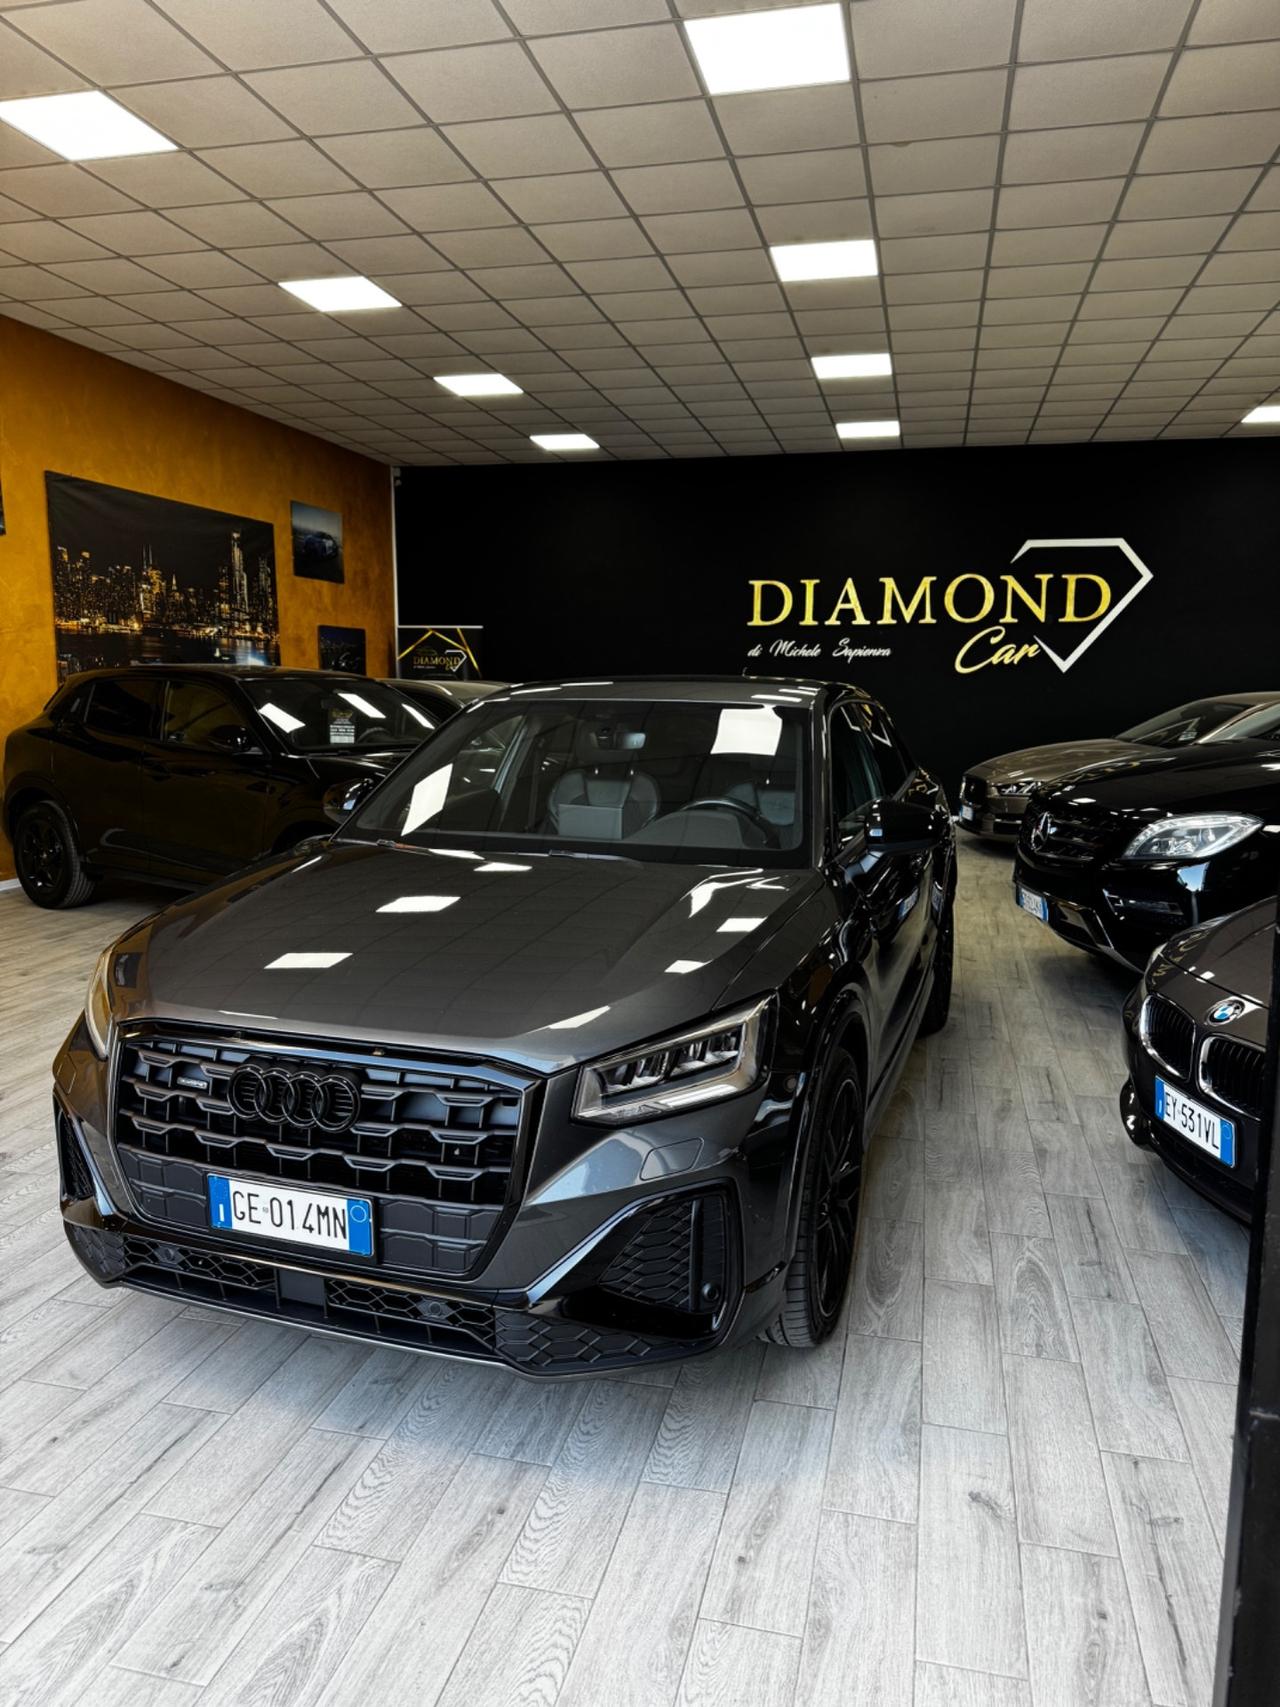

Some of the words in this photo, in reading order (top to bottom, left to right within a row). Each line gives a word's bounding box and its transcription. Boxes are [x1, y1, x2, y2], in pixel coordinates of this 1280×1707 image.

[747, 573, 1112, 626] DIAMOND
[413, 655, 461, 666] DIAMOND
[747, 643, 763, 658] di
[769, 640, 822, 658] Michele
[832, 638, 892, 663] Sapienza
[955, 625, 1042, 673] Car
